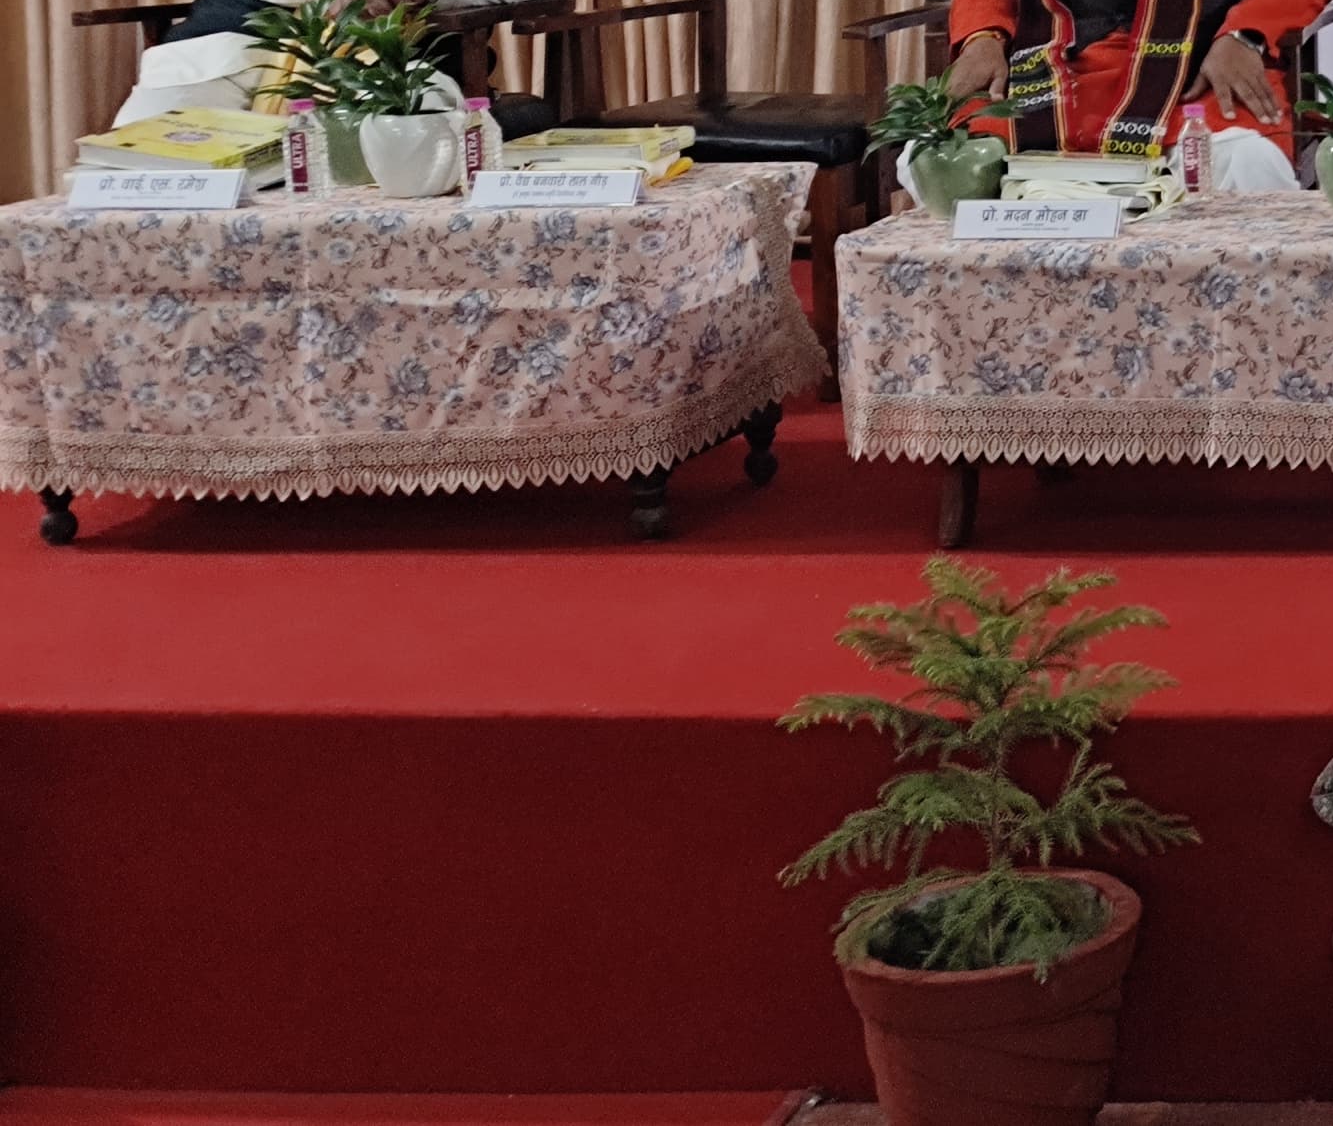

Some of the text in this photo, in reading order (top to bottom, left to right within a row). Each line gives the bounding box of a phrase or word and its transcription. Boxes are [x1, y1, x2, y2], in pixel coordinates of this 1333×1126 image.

[292, 134, 302, 169] ULTRA
[467, 131, 479, 168] ULTRA
[1003, 208, 1032, 222] मदन
[1035, 205, 1068, 223] मोहन
